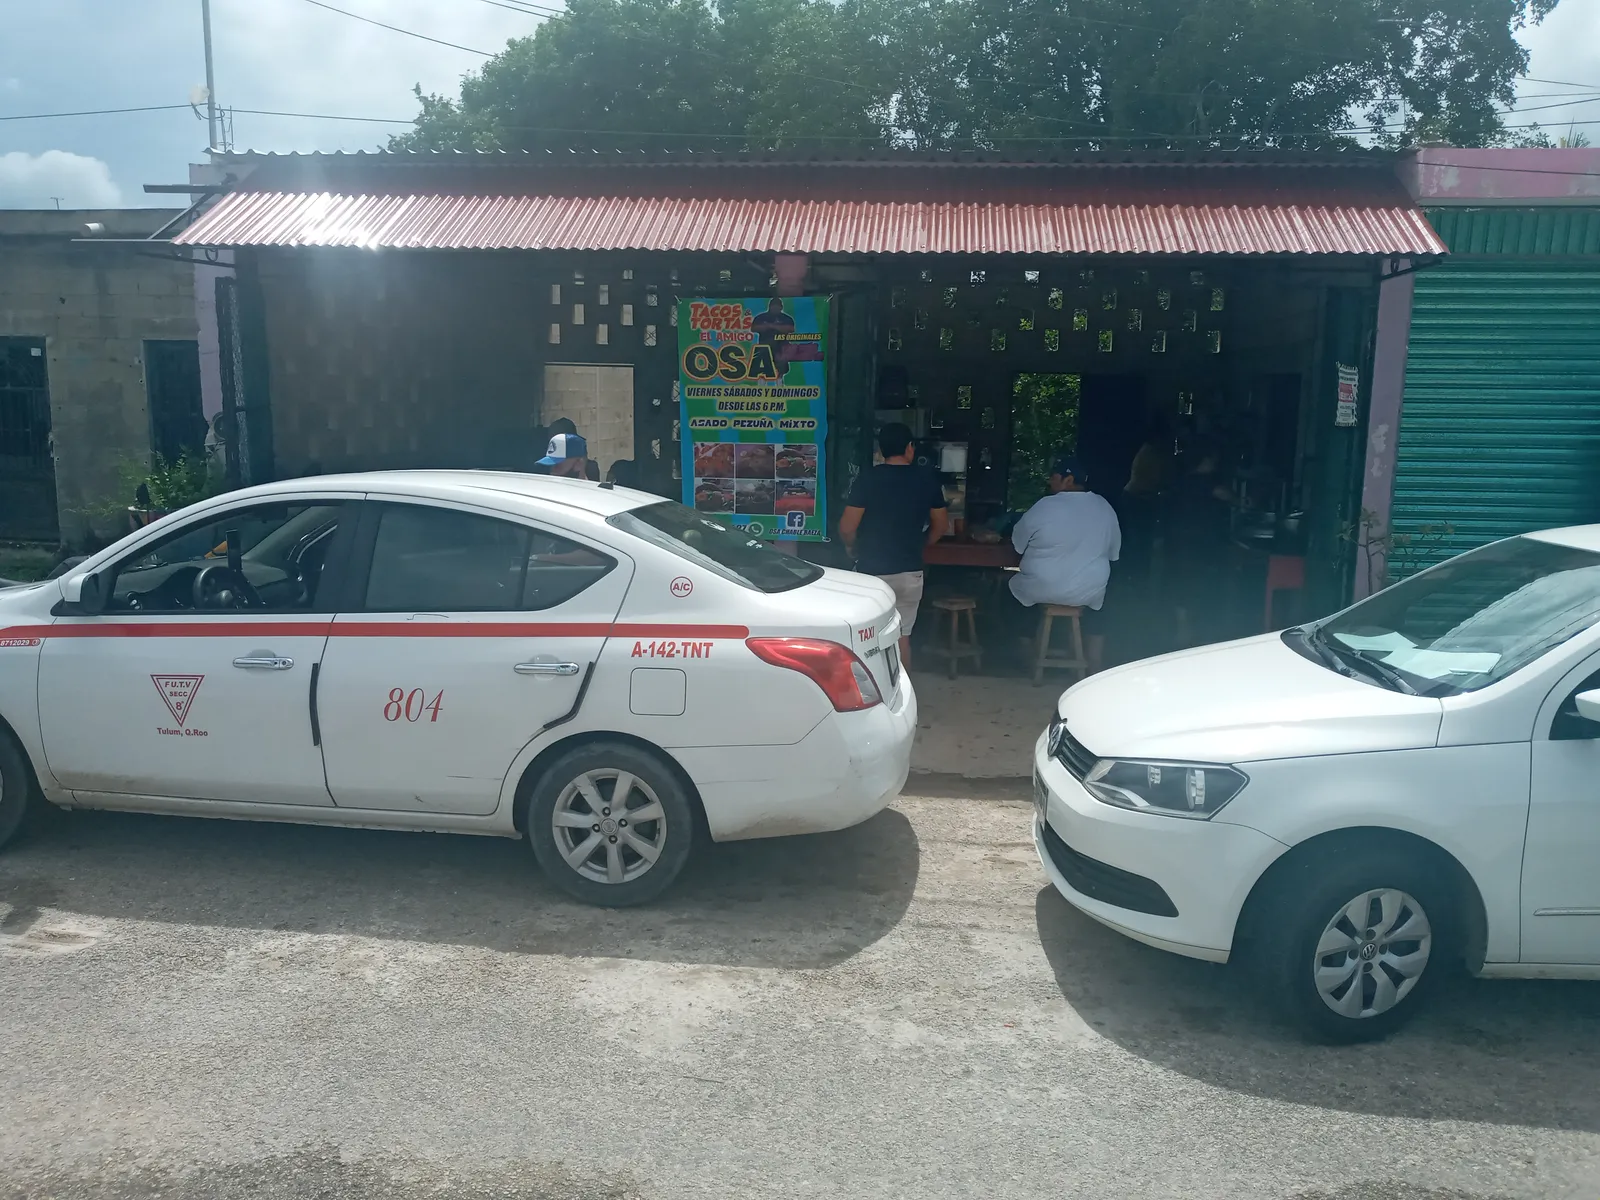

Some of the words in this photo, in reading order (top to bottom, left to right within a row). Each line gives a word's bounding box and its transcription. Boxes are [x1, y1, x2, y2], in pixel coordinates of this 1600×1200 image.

[690, 303, 742, 317] TACOS
[690, 317, 752, 330] TORTAS
[700, 332, 712, 341] EL
[716, 332, 754, 342] AMIGO
[786, 333, 822, 341] ORIGINALES
[684, 344, 778, 381] OSA
[686, 387, 722, 397] VIERNES
[723, 385, 763, 397] SÁBADOS
[764, 388, 771, 397] Y
[771, 388, 819, 398] DOMINGOS
[718, 402, 745, 411] DESDE
[746, 402, 761, 411] LAS
[762, 402, 768, 411] 6
[770, 402, 786, 411] P.M.
[690, 419, 728, 427] ASADO
[732, 417, 774, 428] PEZUÑA
[673, 582, 690, 591] A/C
[858, 626, 875, 642] TAXI
[631, 641, 714, 658] A-142-TNT
[383, 687, 444, 722] 804
[157, 727, 183, 737] Tulum,
[185, 728, 208, 737] Q.Roo
